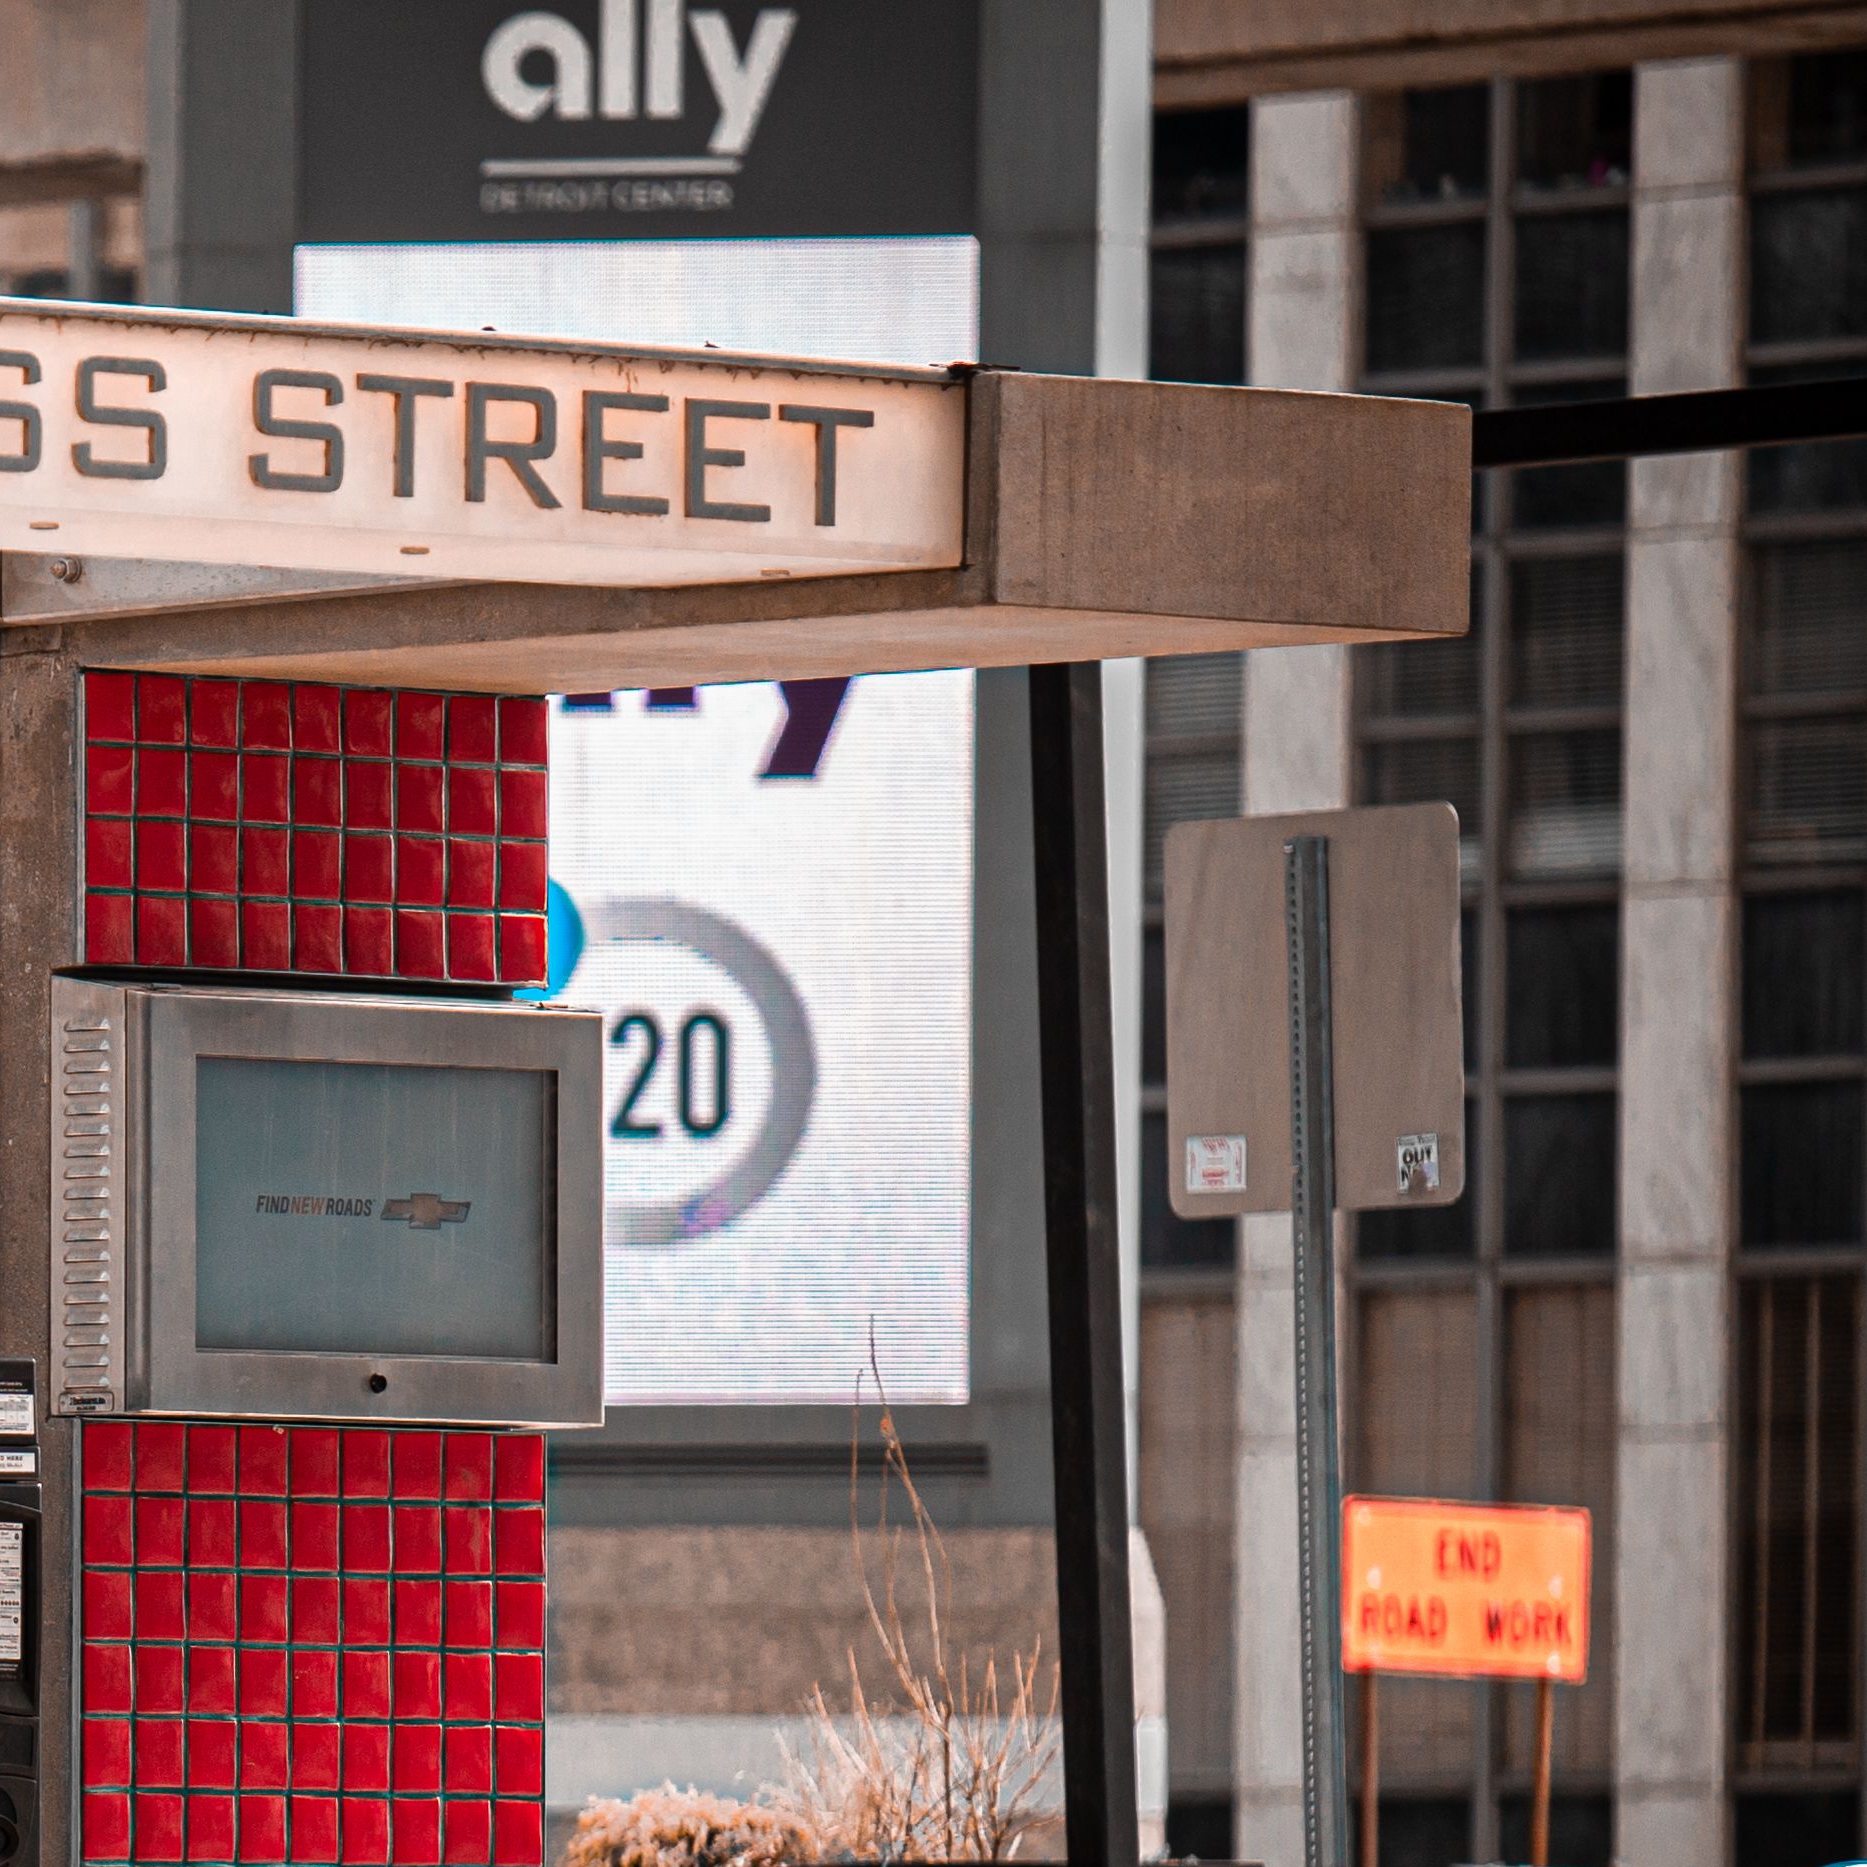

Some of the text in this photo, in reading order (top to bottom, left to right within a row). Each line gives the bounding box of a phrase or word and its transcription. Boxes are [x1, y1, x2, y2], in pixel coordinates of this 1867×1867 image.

[481, 0, 797, 153] ally
[612, 180, 735, 211] CENTER
[248, 367, 874, 526] STREET
[609, 1013, 730, 1139] 20
[256, 1195, 290, 1214] FIND
[325, 1198, 373, 1217] ROADS
[1437, 1527, 1502, 1582] END
[1361, 1593, 1572, 1651] ROAD WORK
